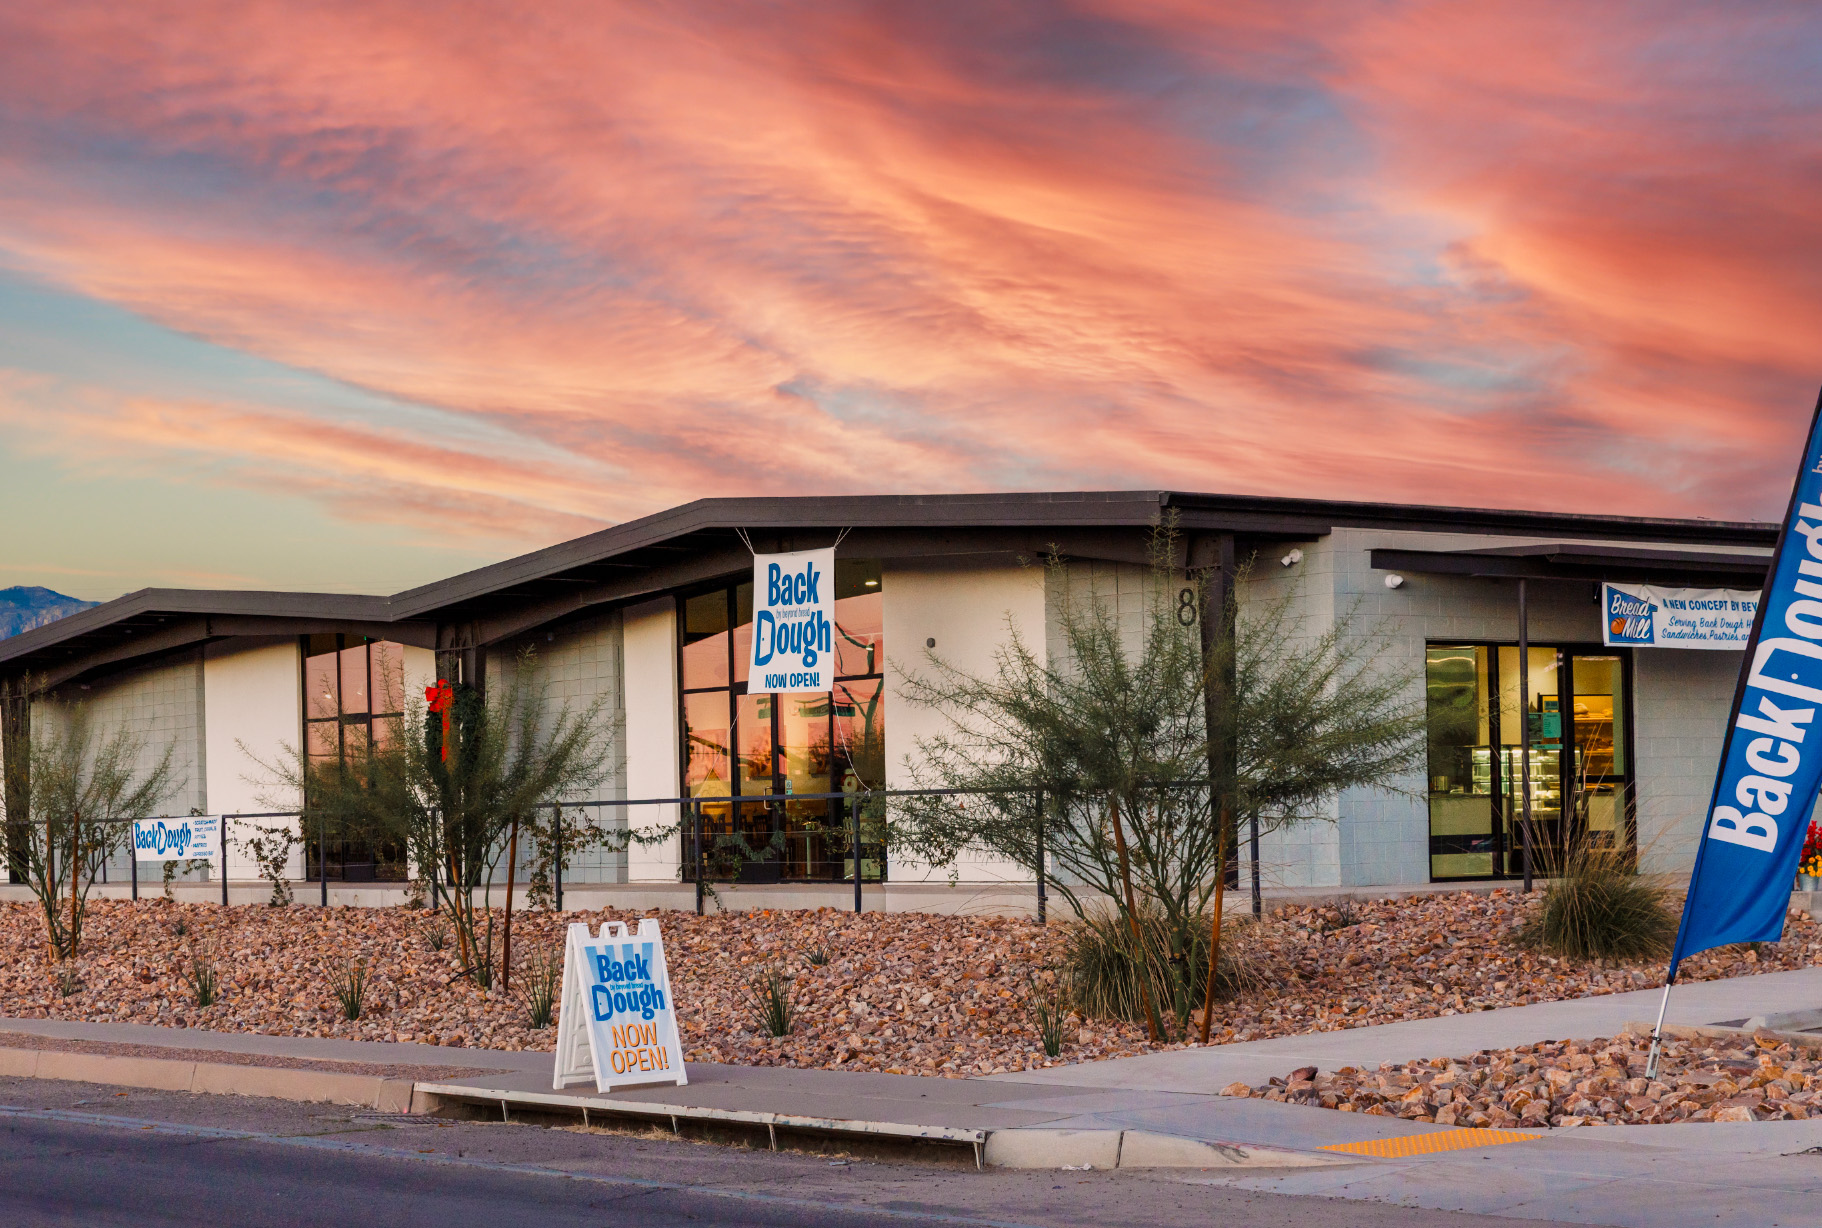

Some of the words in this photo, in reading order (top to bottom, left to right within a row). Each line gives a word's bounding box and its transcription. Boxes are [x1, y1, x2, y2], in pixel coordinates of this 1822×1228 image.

[768, 562, 820, 606] Back
[1177, 588, 1196, 626] 8
[1611, 594, 1650, 616] Bread
[1662, 598, 1669, 608] A
[1669, 599, 1686, 610] NEW
[1689, 600, 1728, 610] CONCEPT
[1731, 601, 1739, 611] BY
[1621, 617, 1650, 639] Mill
[1668, 616, 1697, 632] Serving
[1700, 617, 1717, 627] Back
[1720, 618, 1743, 633] Dough
[754, 610, 831, 668] Dough
[765, 673, 787, 688] NOW
[790, 672, 820, 687] OPEN!
[596, 953, 651, 983] Back
[592, 983, 665, 1022] Dough
[611, 1021, 658, 1048] NOW
[610, 1046, 670, 1074] OPEN!
